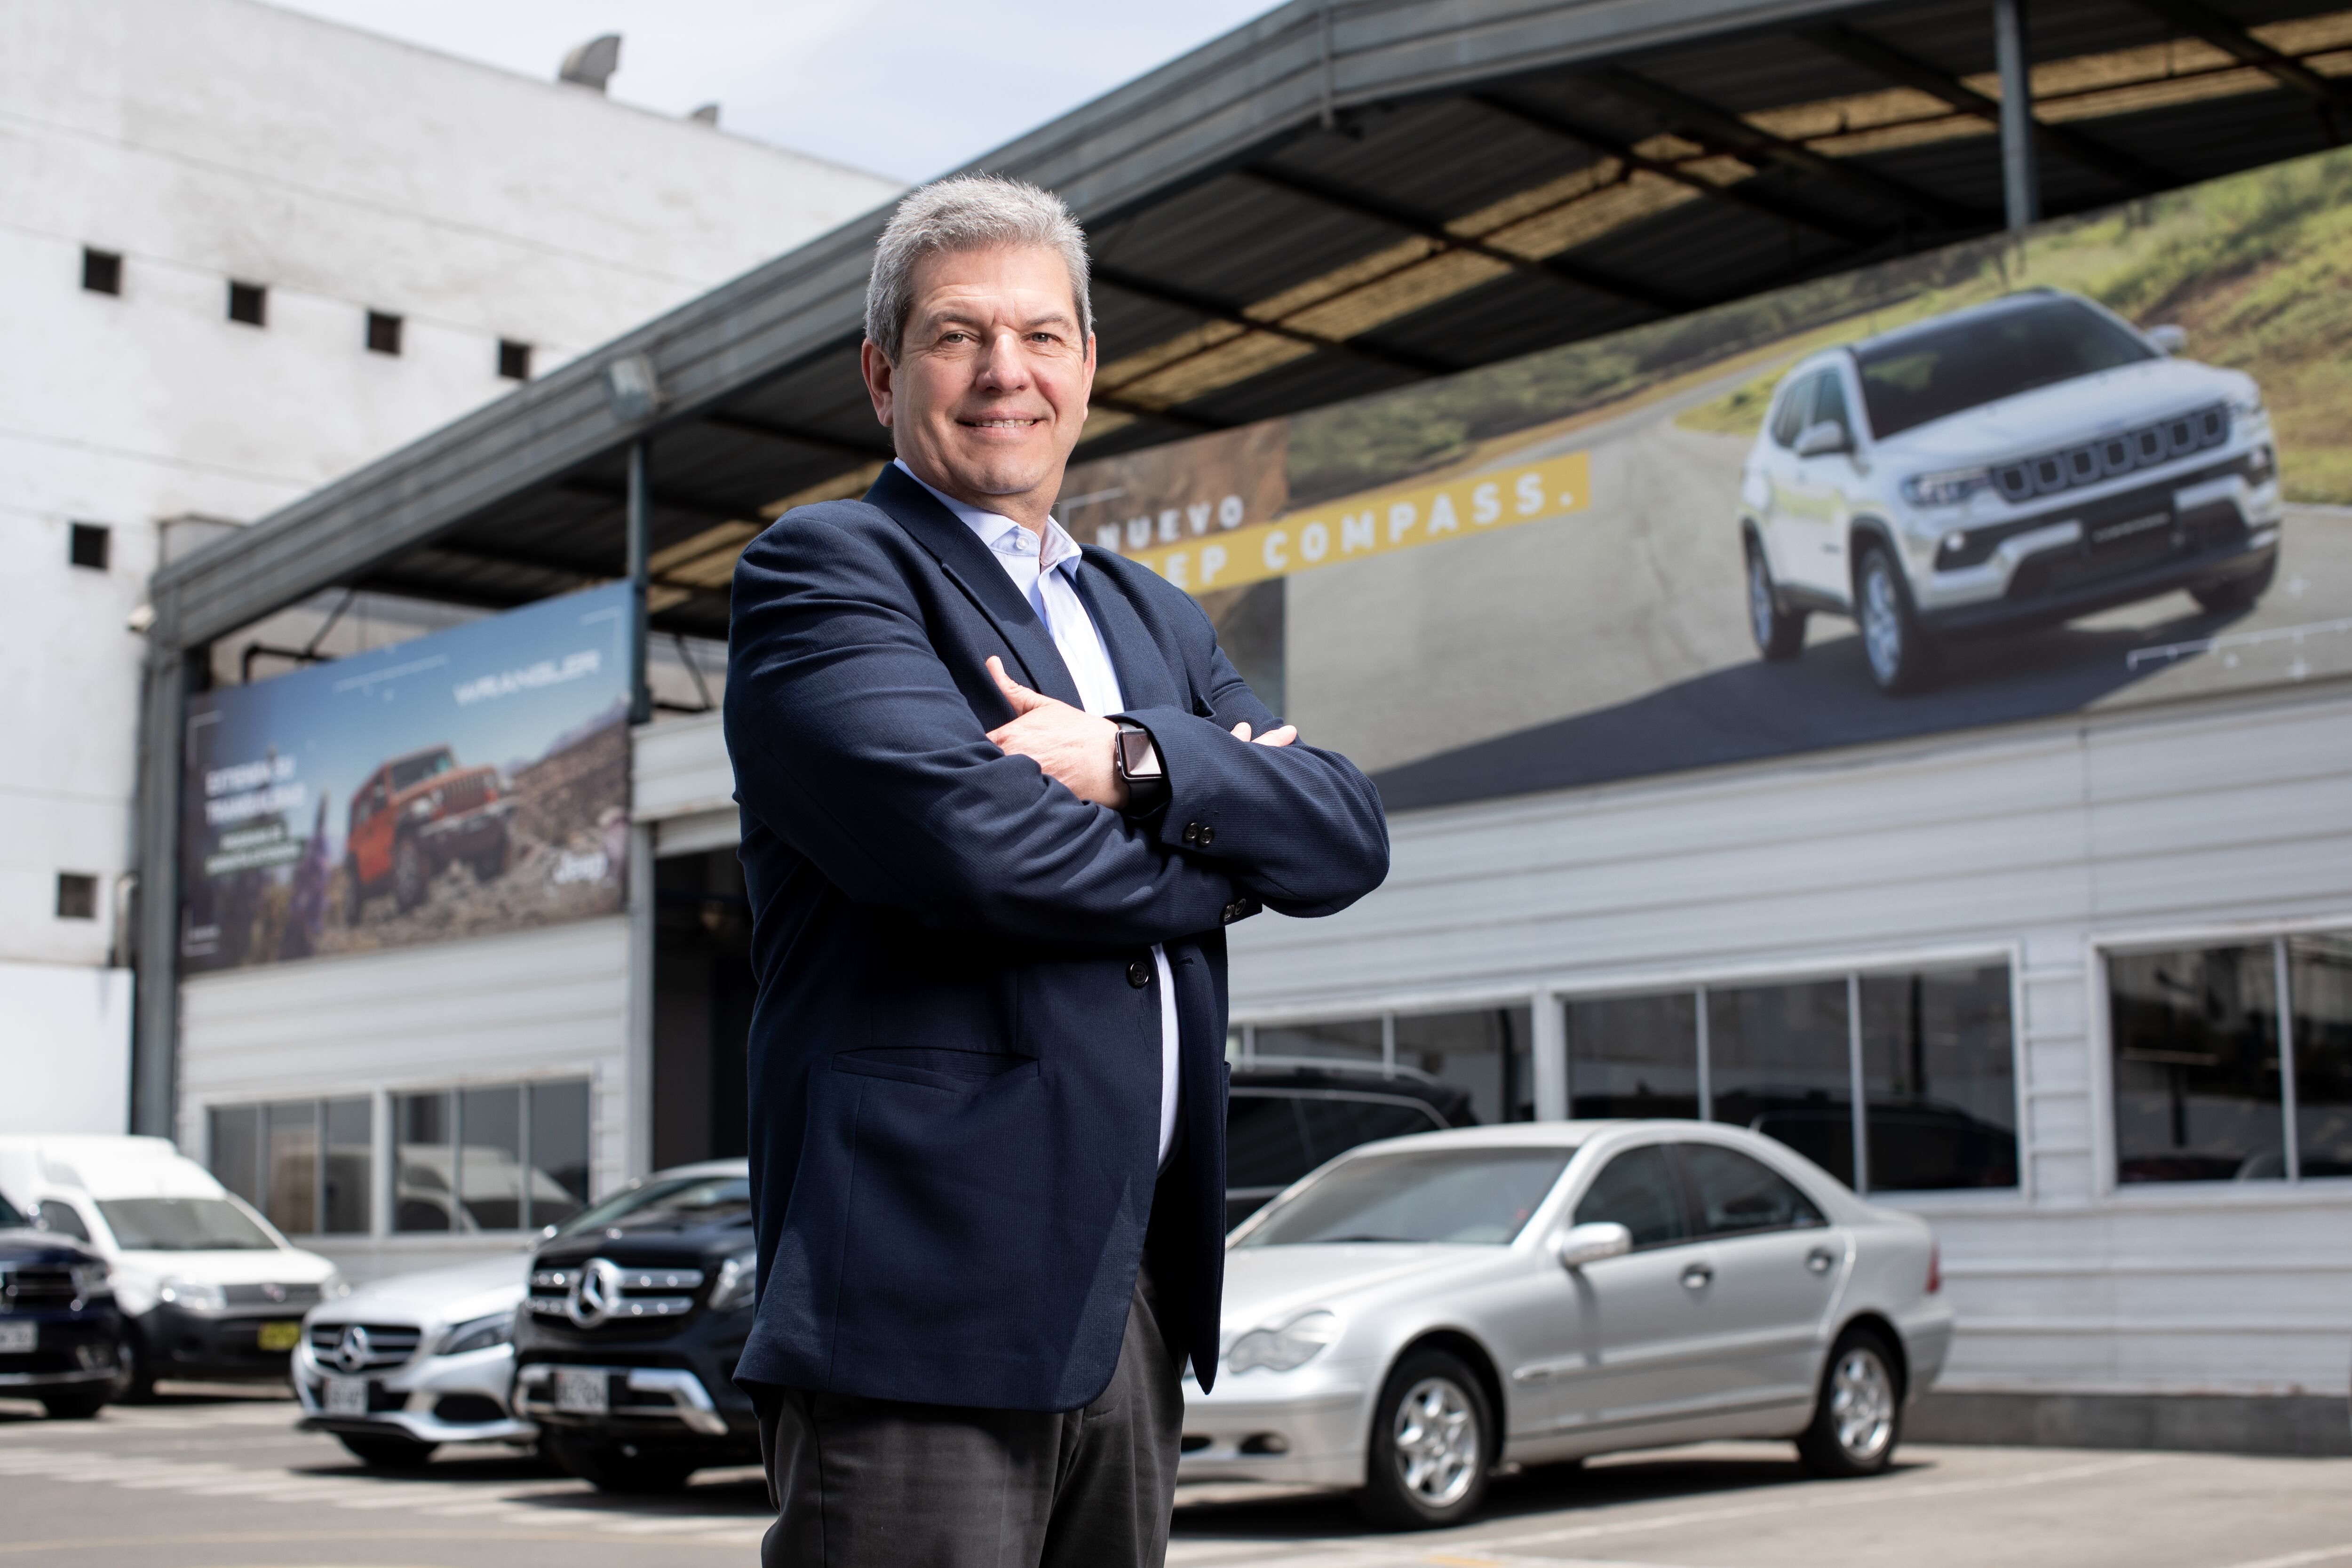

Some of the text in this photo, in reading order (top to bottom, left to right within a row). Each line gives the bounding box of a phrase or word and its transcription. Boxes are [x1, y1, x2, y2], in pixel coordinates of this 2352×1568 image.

[1096, 494, 1244, 552] NUEVO
[1138, 472, 1574, 589] EP COMPASS.
